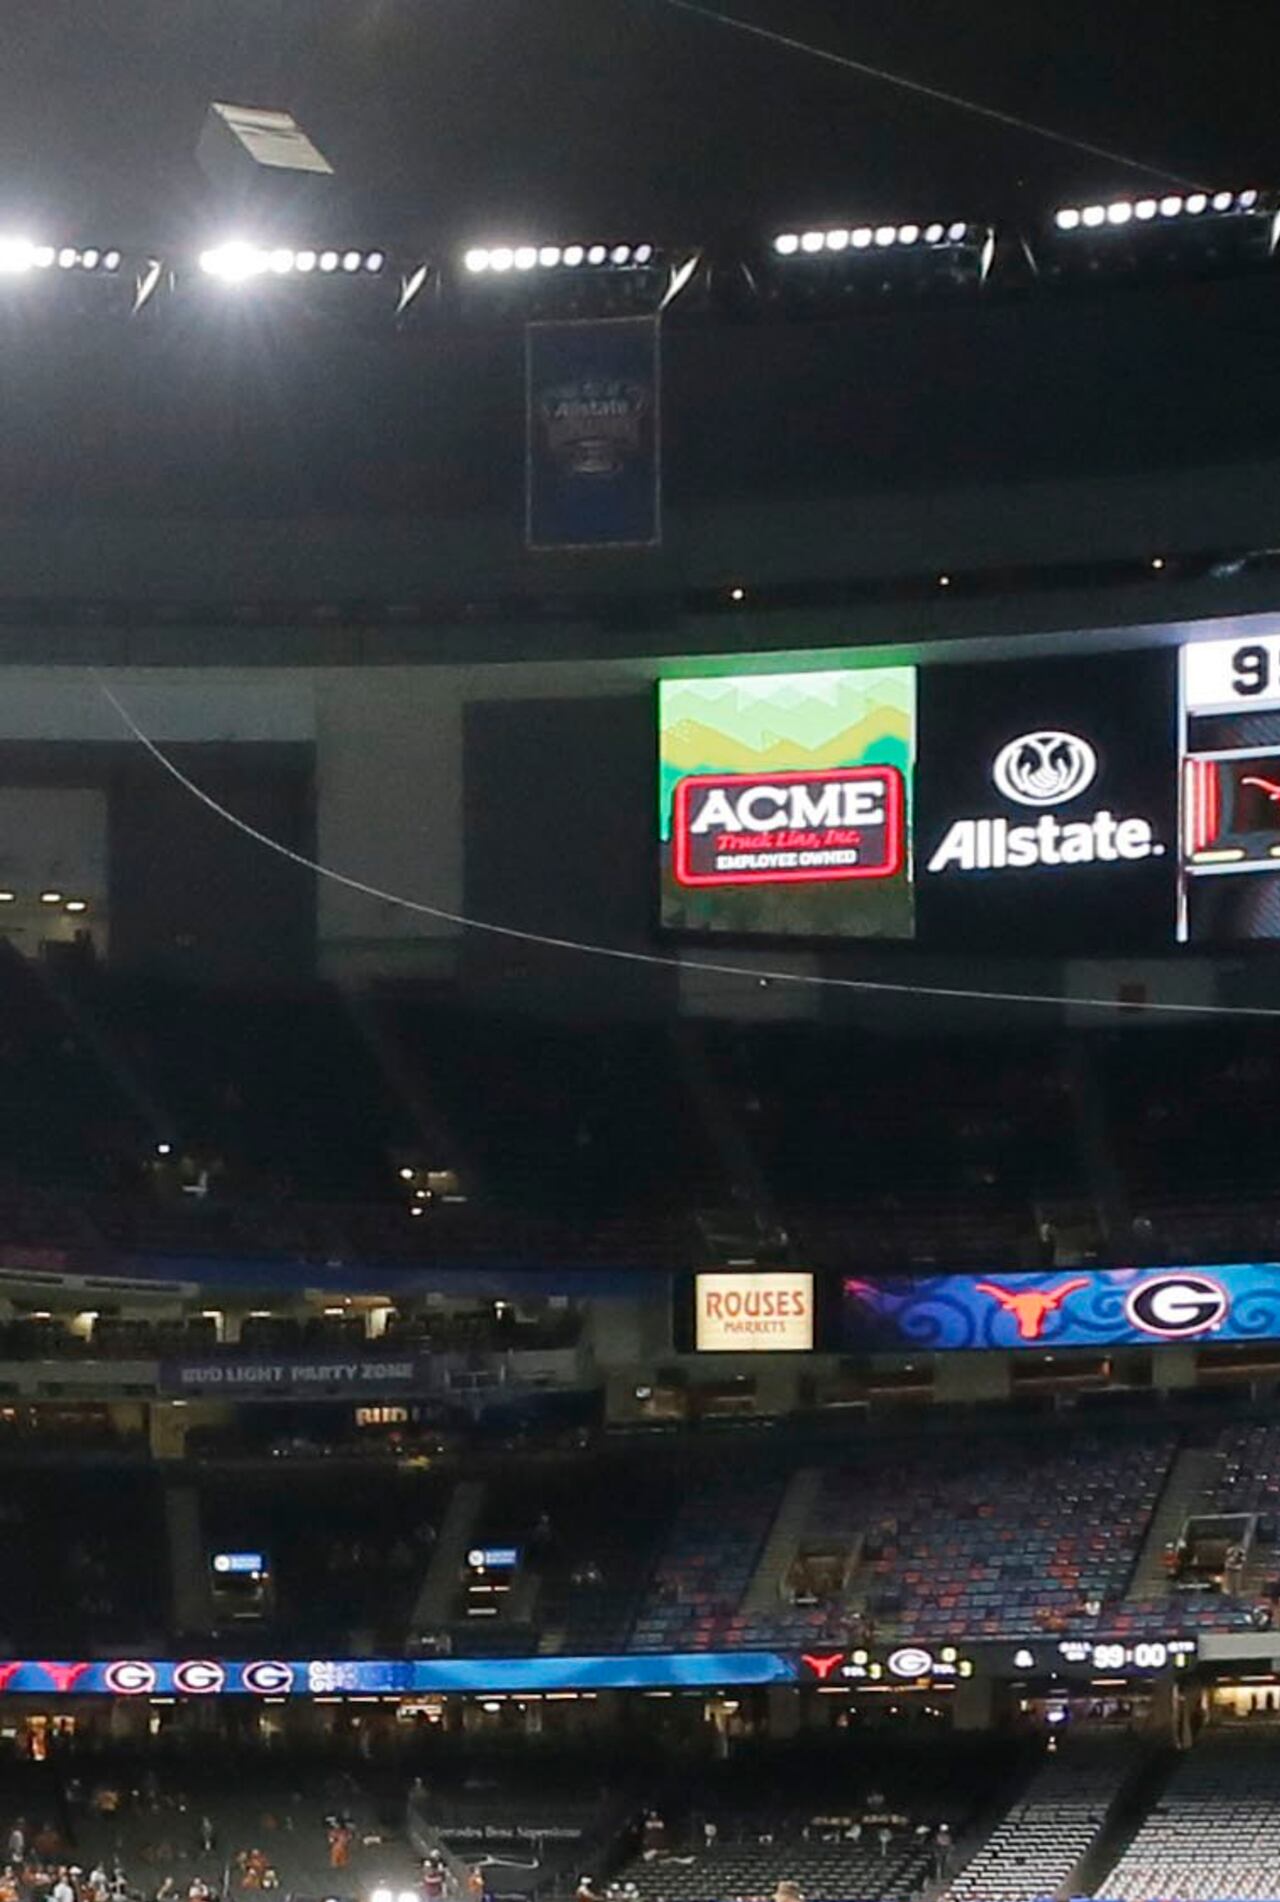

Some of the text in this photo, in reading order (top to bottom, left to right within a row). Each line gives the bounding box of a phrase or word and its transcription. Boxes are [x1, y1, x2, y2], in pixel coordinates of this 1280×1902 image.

[690, 780, 885, 834] ACME
[716, 850, 858, 871] EMPLOYEE OWNED
[706, 1291, 806, 1319] ROUSES
[724, 1320, 787, 1334] MARKETS
[225, 1365, 284, 1383] LIGHT
[291, 1364, 357, 1382] PARTY
[362, 1362, 414, 1380] ZONE
